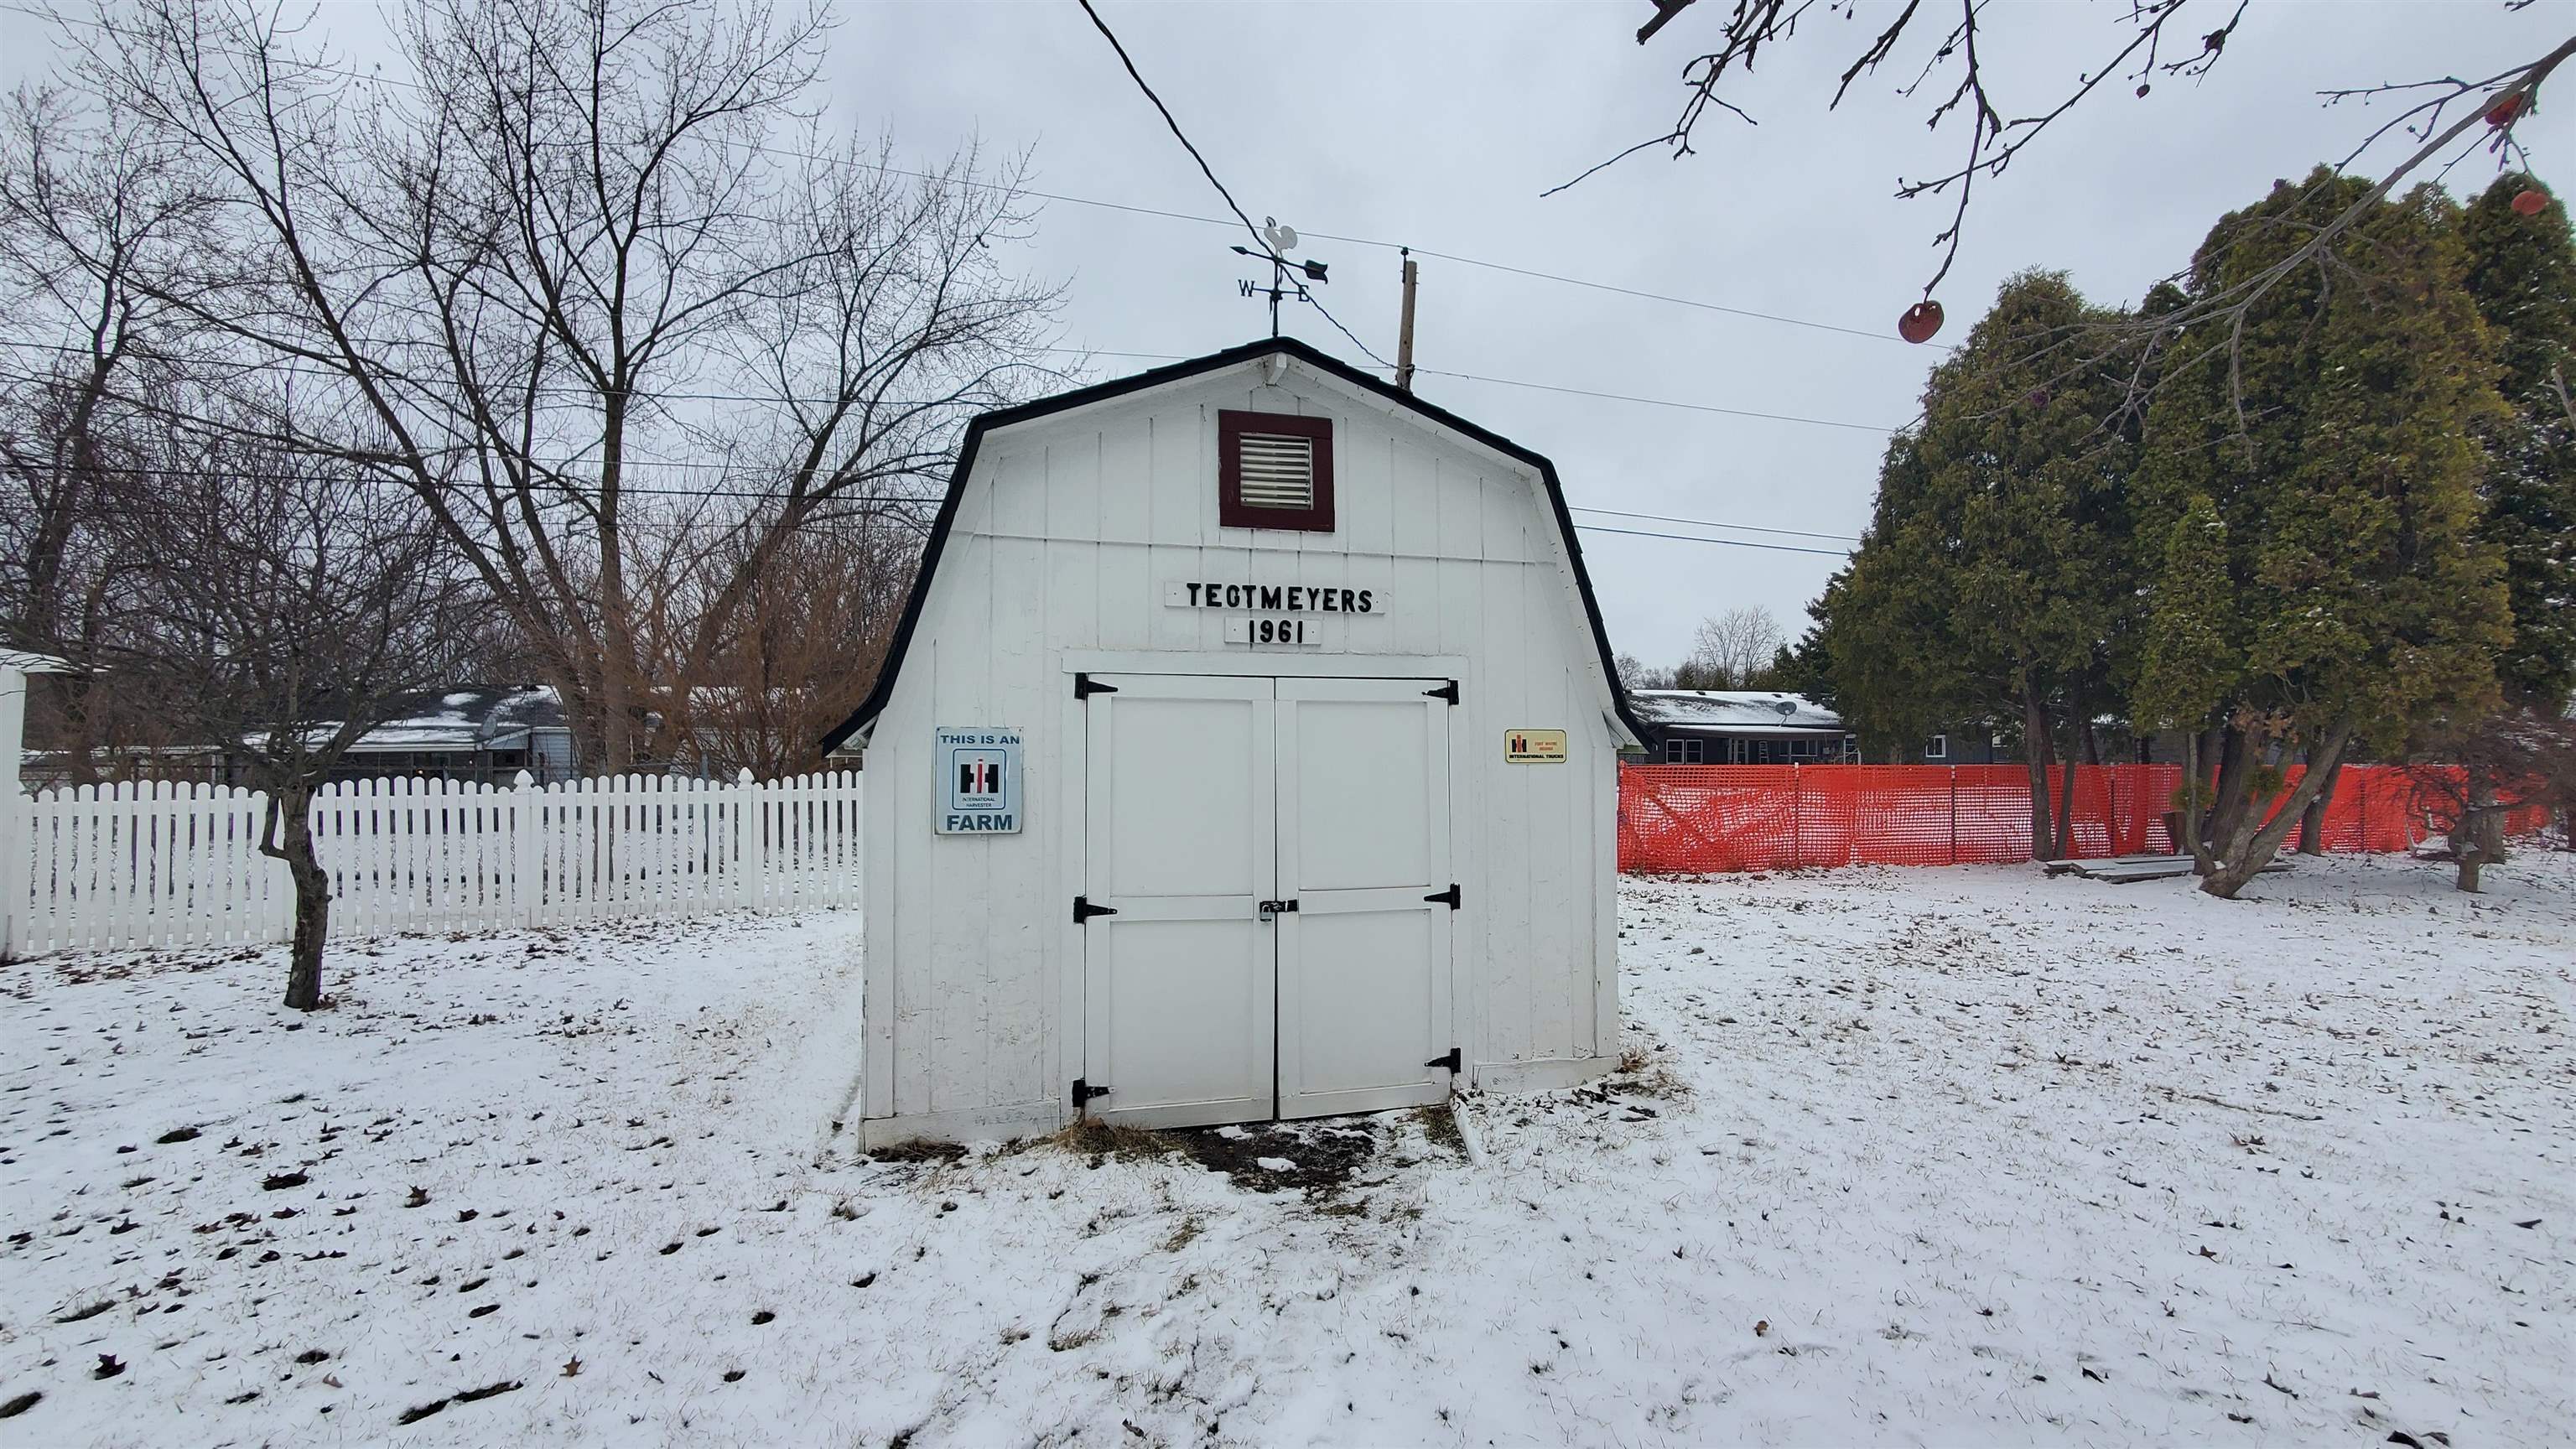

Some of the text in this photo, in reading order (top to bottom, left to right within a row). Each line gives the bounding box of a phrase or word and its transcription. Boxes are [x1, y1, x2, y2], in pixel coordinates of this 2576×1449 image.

[1238, 279, 1255, 297] W
[1249, 620, 1303, 643] 1961
[940, 735, 975, 744] THIS
[981, 735, 995, 744] IS
[947, 814, 1012, 831] FARM
